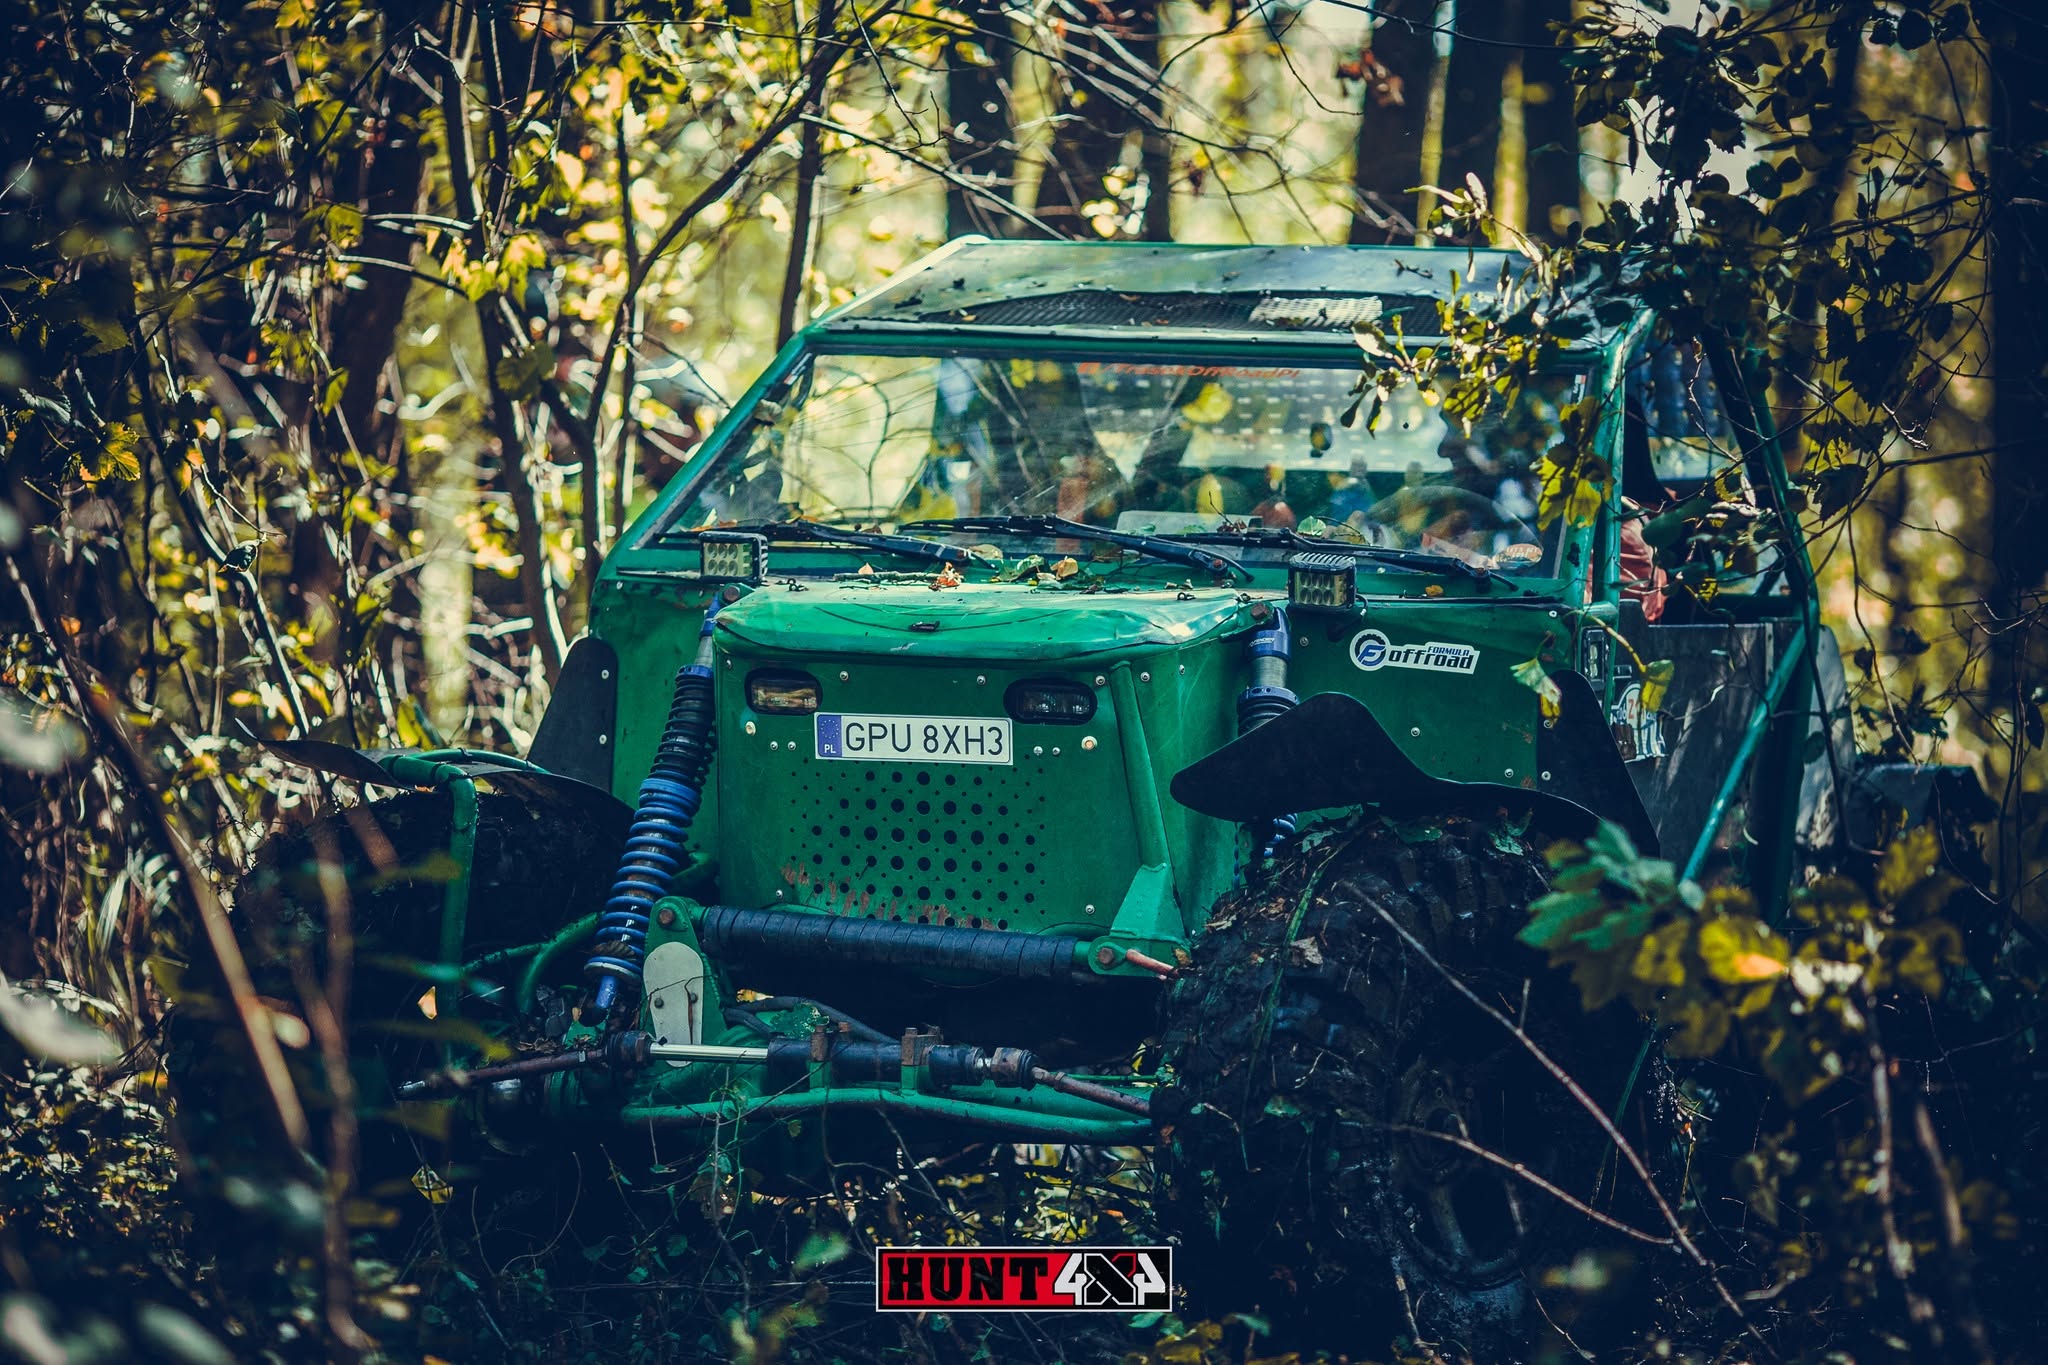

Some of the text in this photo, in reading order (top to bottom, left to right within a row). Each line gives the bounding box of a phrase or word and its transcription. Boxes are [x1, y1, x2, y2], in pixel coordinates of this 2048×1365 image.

[1427, 646, 1470, 656] FORMULA
[1388, 649, 1474, 669] offroad
[845, 722, 1003, 756] GPU 8XH3
[823, 744, 837, 755] PL
